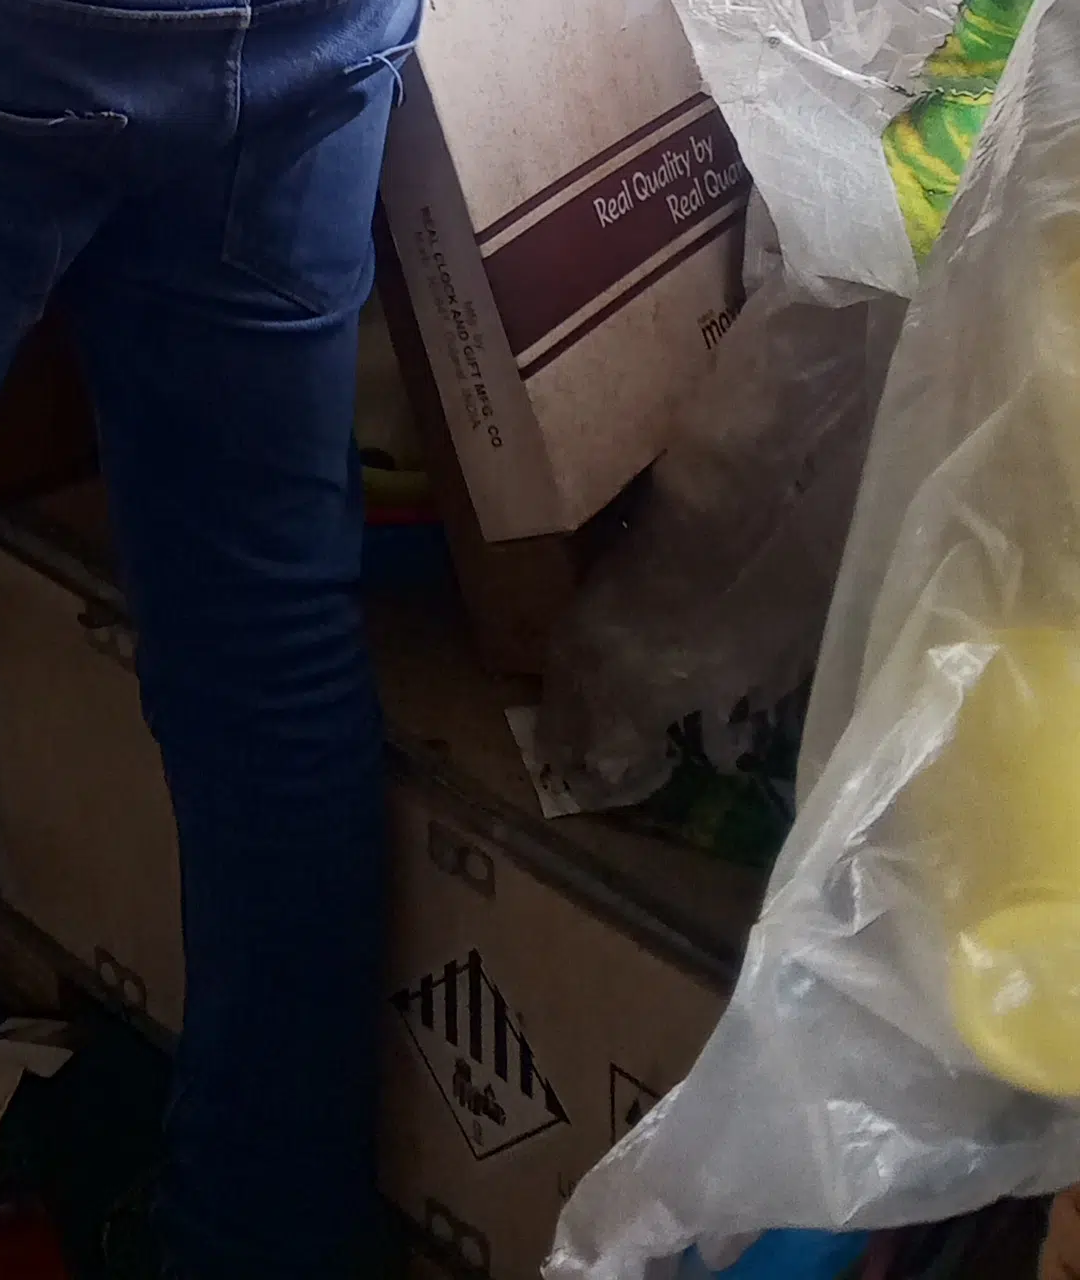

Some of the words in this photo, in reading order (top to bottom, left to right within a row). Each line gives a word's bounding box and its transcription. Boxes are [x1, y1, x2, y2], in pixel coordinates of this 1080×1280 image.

[593, 179, 634, 229] Real
[633, 149, 692, 202] Quality
[689, 135, 713, 164] by
[666, 177, 706, 225] Real
[434, 252, 459, 305] CLOCK
[451, 309, 469, 341] AND
[463, 345, 482, 378] GIFT
